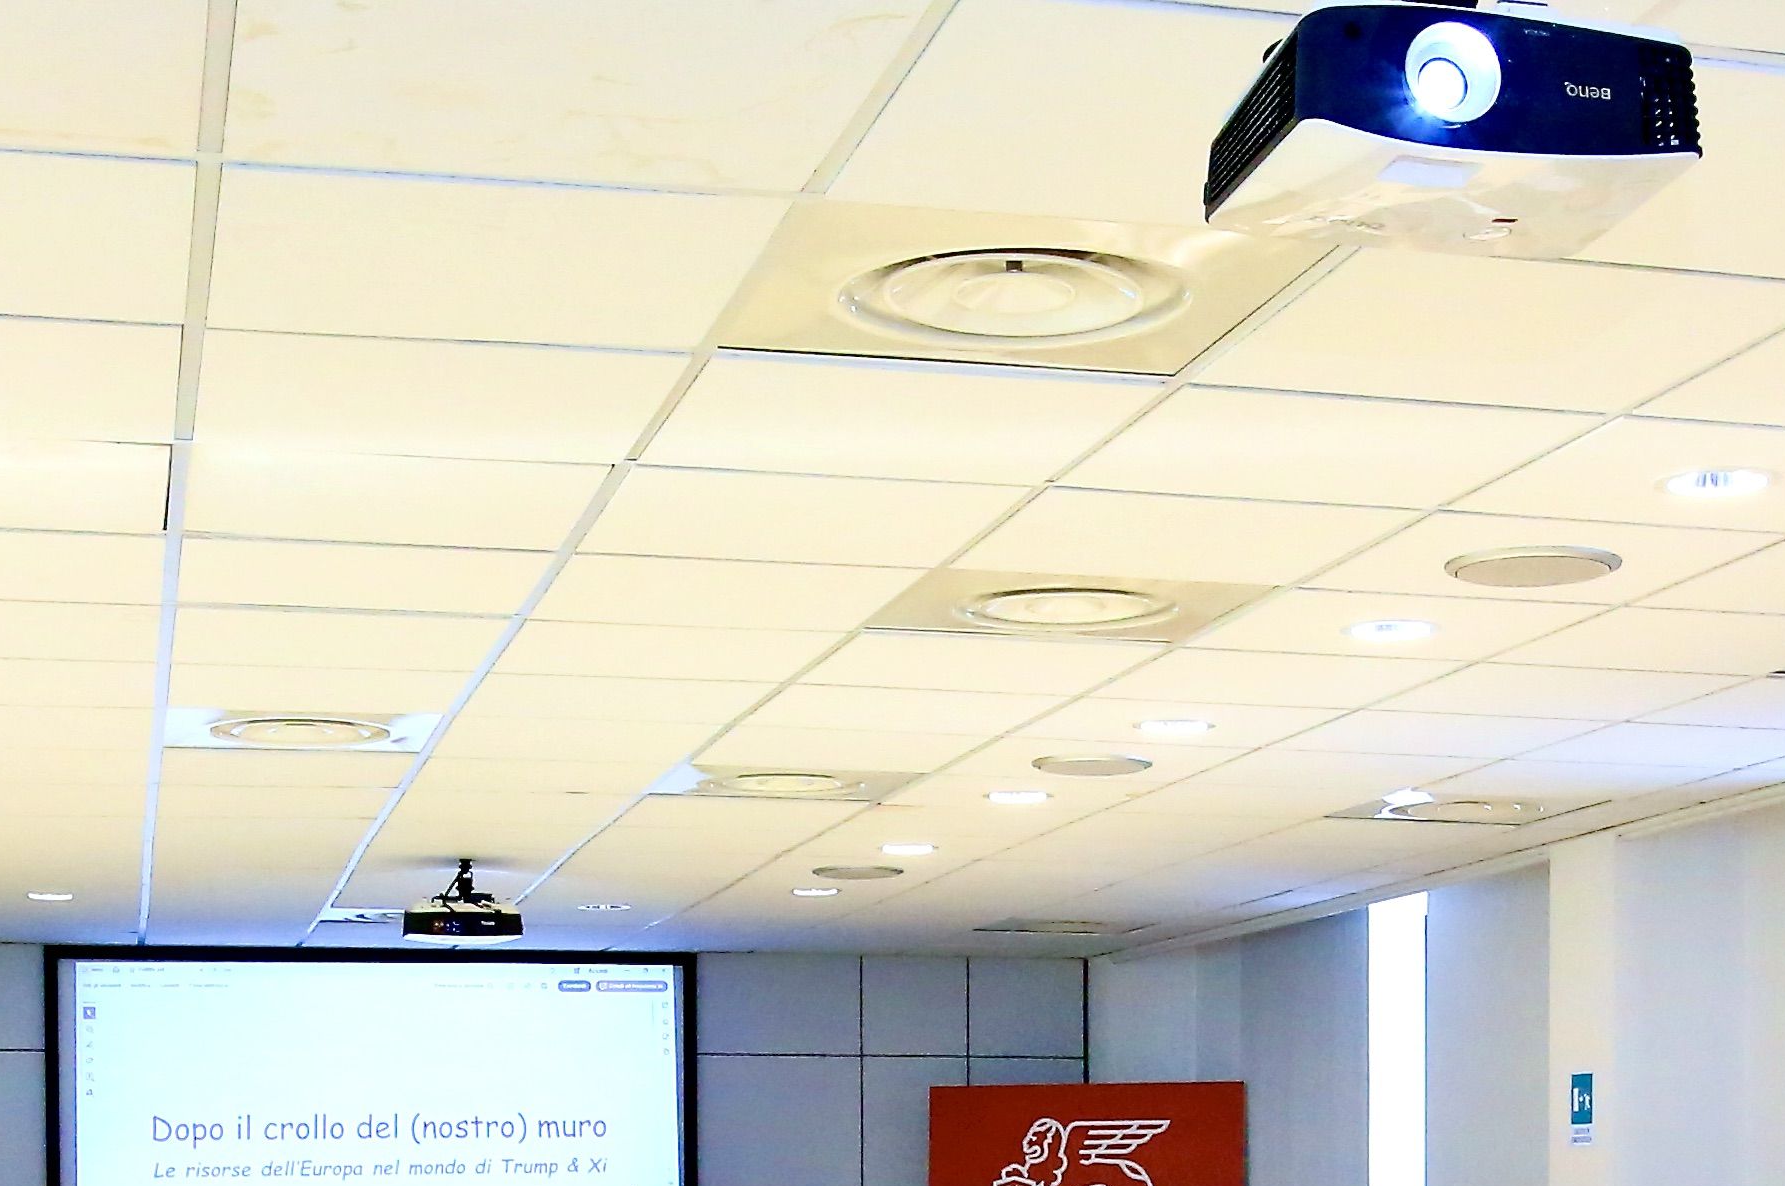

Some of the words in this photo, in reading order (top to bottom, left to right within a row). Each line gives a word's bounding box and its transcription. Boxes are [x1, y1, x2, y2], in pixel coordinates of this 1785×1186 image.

[1564, 81, 1611, 100] BenQ
[152, 1115, 224, 1149] Dopo
[236, 1114, 251, 1141] il
[263, 1113, 345, 1141] crollo
[356, 1113, 398, 1140] del
[411, 1112, 527, 1145] (nostro)
[537, 1119, 607, 1139] muro
[153, 1162, 176, 1178] Le
[185, 1162, 252, 1178] risorse
[261, 1159, 363, 1181] dell'Europa
[373, 1159, 400, 1176] nel
[409, 1159, 466, 1175] mondo
[475, 1158, 493, 1175] di
[501, 1158, 559, 1178] Trump
[567, 1157, 580, 1173] &
[588, 1157, 608, 1174] Xi
